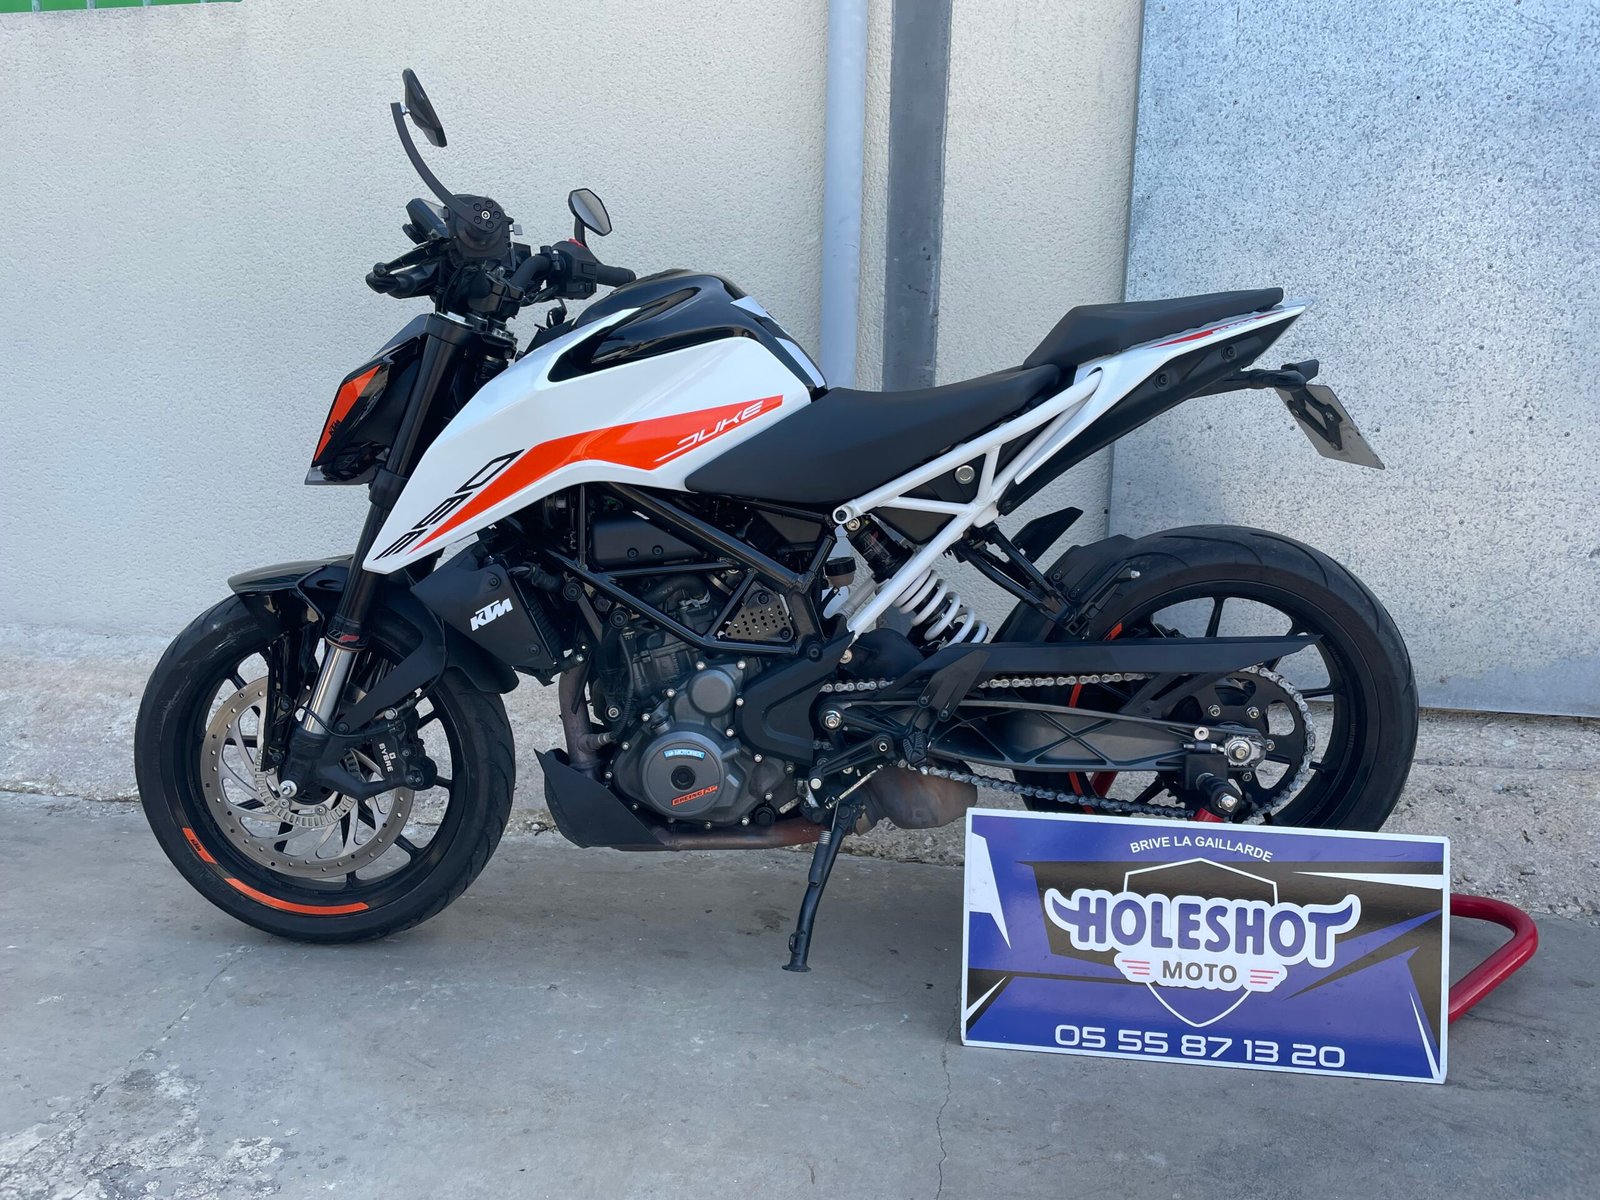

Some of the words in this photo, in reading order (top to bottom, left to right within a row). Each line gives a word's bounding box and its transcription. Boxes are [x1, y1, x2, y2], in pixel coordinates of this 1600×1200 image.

[654, 400, 764, 462] DUKE
[470, 597, 514, 632] KTM
[378, 742, 394, 773] BYBRE
[1130, 836, 1171, 854] BRIVE
[1174, 835, 1192, 847] LA
[1194, 836, 1274, 863] GAILLARDE
[1051, 895, 1354, 961] HOLESHOT
[1162, 960, 1238, 985] MOTO
[1055, 1024, 1106, 1049] 05
[1118, 1029, 1168, 1054] 55
[1181, 1034, 1233, 1059] 87
[1243, 1039, 1279, 1064] 13
[1291, 1043, 1346, 1069] 20
